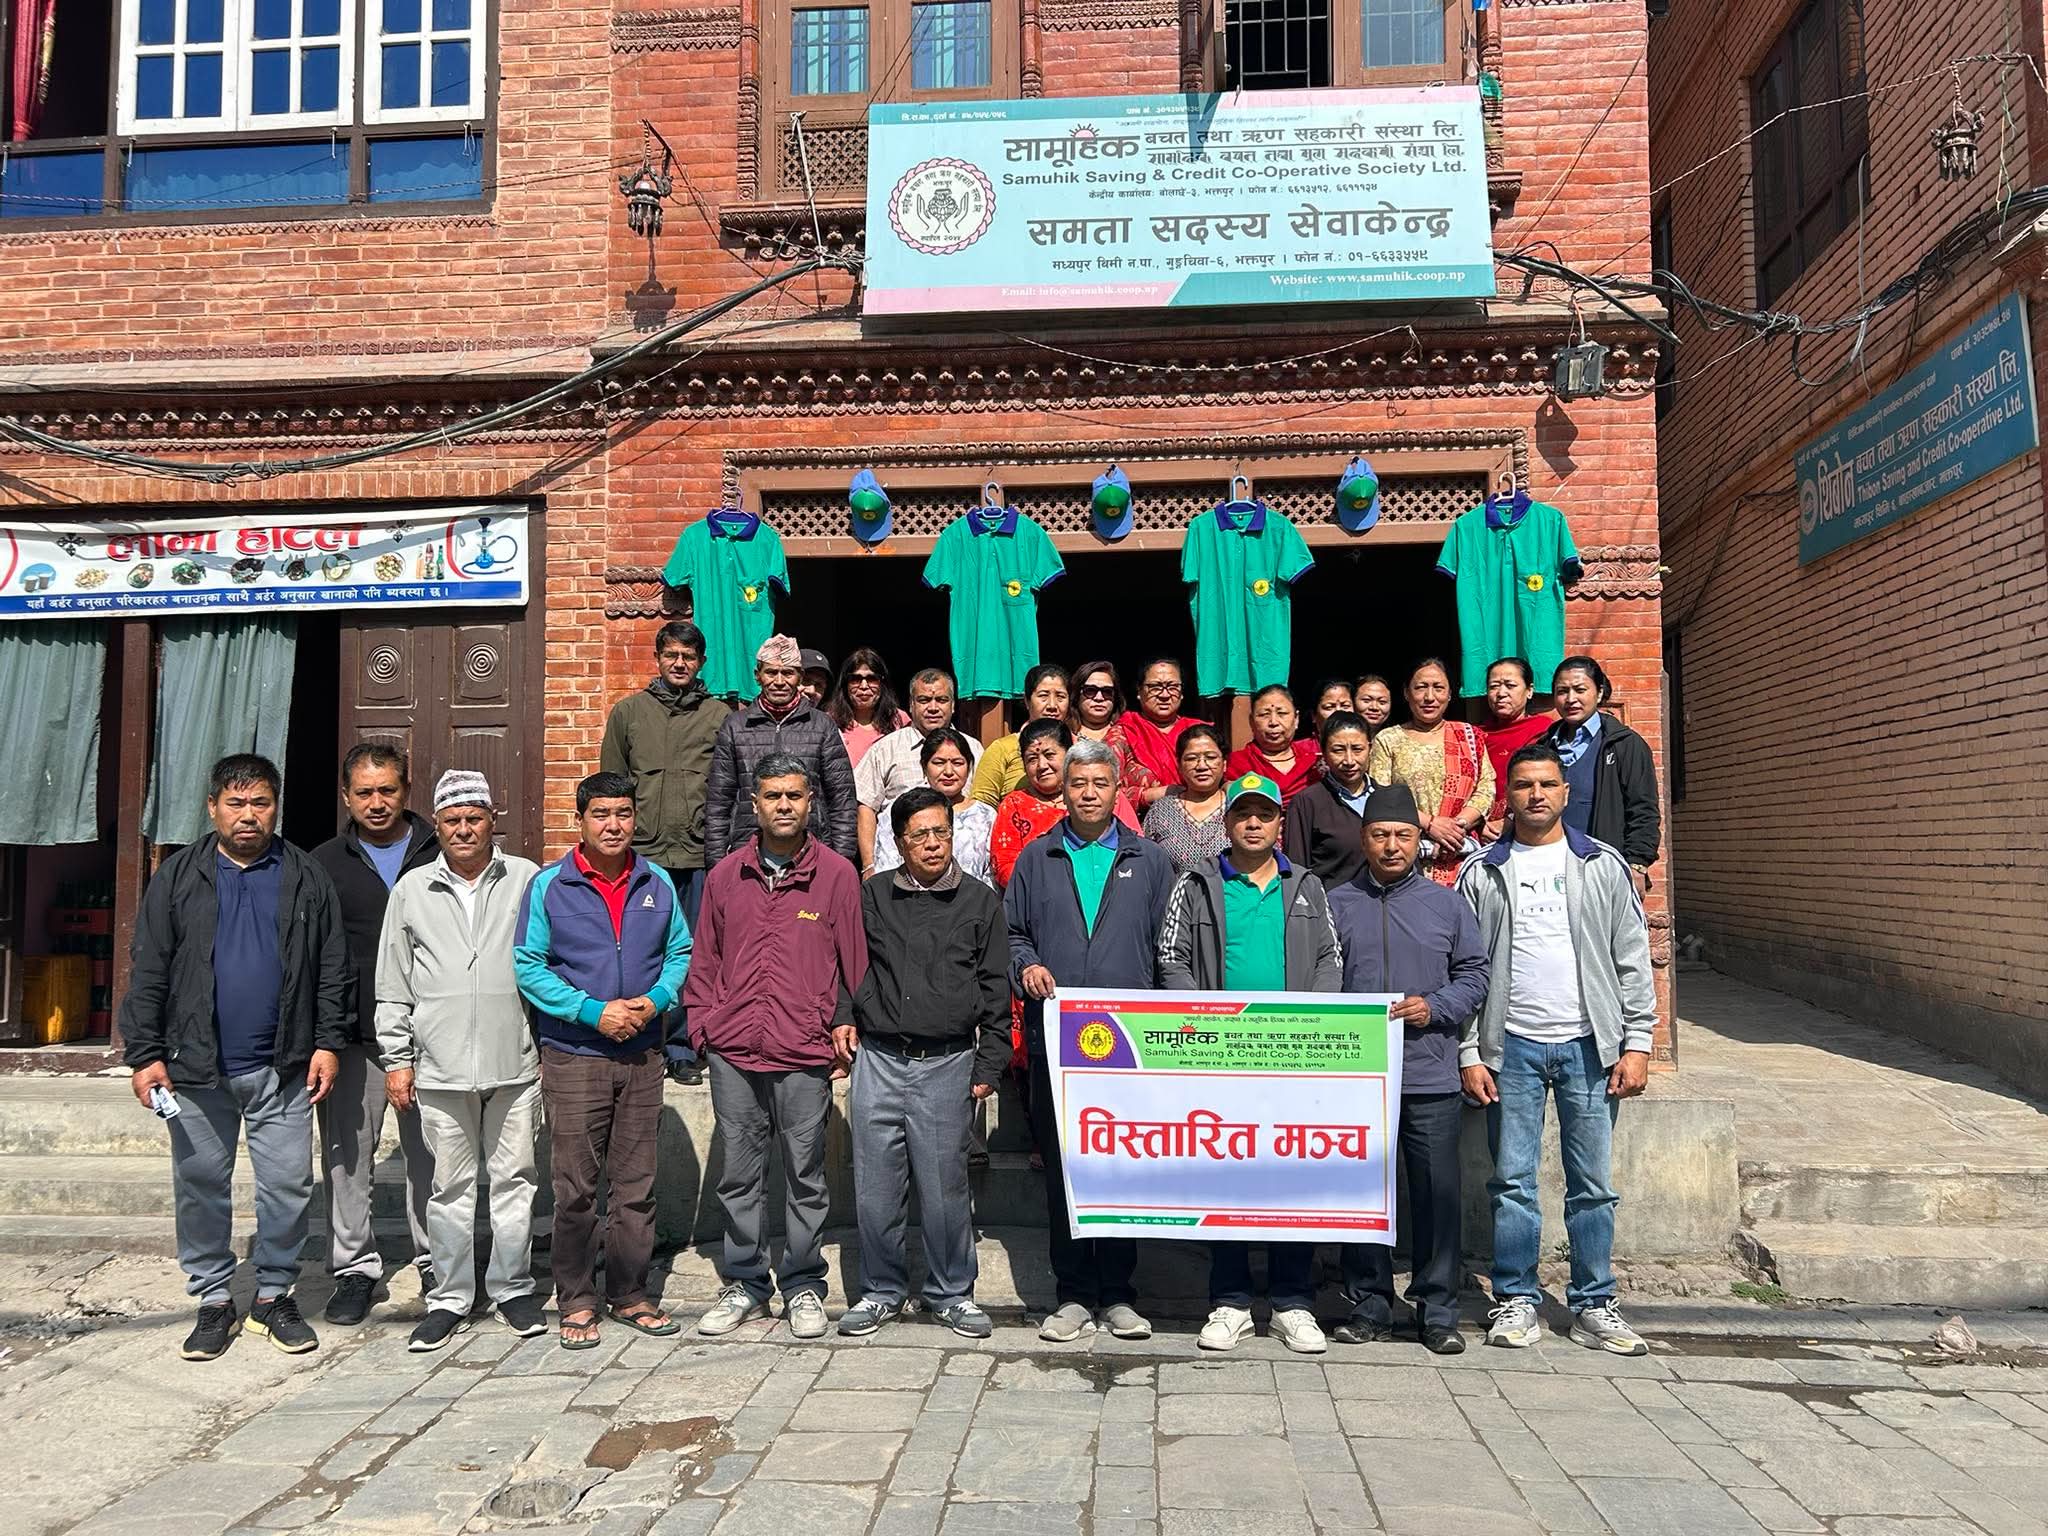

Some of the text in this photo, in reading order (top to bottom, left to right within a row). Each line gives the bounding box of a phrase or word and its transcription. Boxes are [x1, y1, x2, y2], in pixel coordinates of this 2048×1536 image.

[1145, 120, 1463, 145] बचत तथा ऋण सहकारी संस्था लि.
[1003, 129, 1140, 168] सामूहिक
[1002, 160, 1467, 185] Samuhik Saving & Credit Co-Operative Society Ltd.
[1205, 187, 1234, 198] भक्तपुर
[1026, 200, 1453, 246] समता सदस्य सेवाकेन्द्र
[1052, 259, 1092, 271] मध्यपुर
[1235, 254, 1275, 267] भक्तपुर
[1295, 251, 1319, 263] फोन
[1270, 271, 1466, 286] Website: www.samuhik.coop.np
[1001, 285, 1158, 298] Email: info@samuhik.coop.np
[1856, 450, 1875, 474] बचत
[1877, 440, 1895, 464] तथा
[1921, 384, 1963, 432] सहकारी
[1965, 364, 1997, 405] संस्था
[1881, 465, 1906, 492] Saving
[1906, 458, 1920, 477] and
[1922, 441, 1947, 471] Credit
[1947, 407, 2003, 453] Co-operative
[2005, 391, 2025, 419] Ltd.
[77, 595, 112, 610] अनुसार
[280, 589, 315, 603] अनुसार
[363, 586, 381, 598] पनि
[1521, 906, 1562, 914] ITALI
[1144, 1026, 1219, 1049] सामूहिक
[1145, 1048, 1187, 1057] Samuhik
[1191, 1049, 1224, 1059] Saving
[1237, 1049, 1267, 1058] Credit
[1305, 1050, 1342, 1060] Society
[1078, 1106, 1371, 1160] विस्तारित मञ्च
